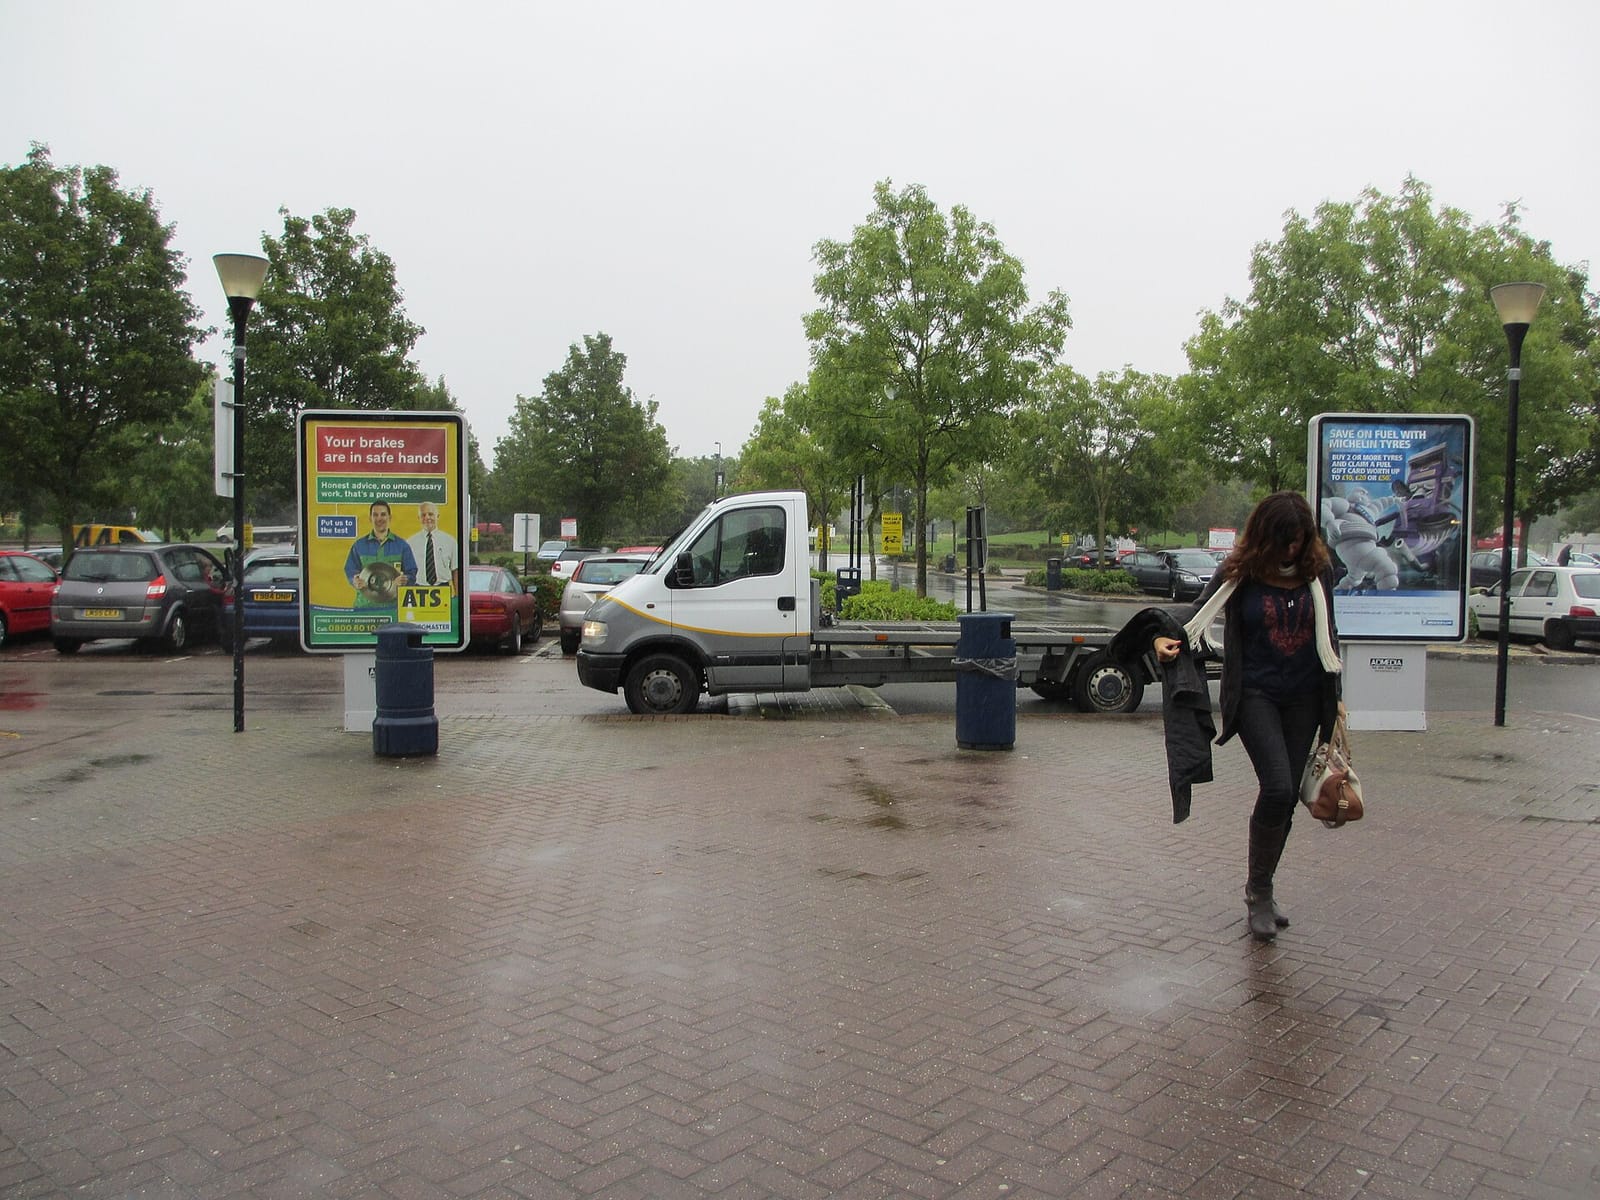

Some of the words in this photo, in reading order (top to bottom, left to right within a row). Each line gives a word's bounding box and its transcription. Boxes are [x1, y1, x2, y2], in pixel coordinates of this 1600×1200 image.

[1330, 429, 1355, 438] SAVE
[1357, 430, 1373, 438] ON
[1375, 430, 1398, 439] FUEL
[1401, 430, 1426, 440] WITH
[324, 436, 355, 448] Your
[360, 436, 404, 448] brakes
[1330, 440, 1377, 448] MICHELIN
[1380, 440, 1411, 449] TYRES
[324, 454, 346, 462] are
[350, 452, 361, 463] in
[366, 452, 394, 463] safe
[398, 452, 439, 464] hands
[376, 491, 408, 499] promise
